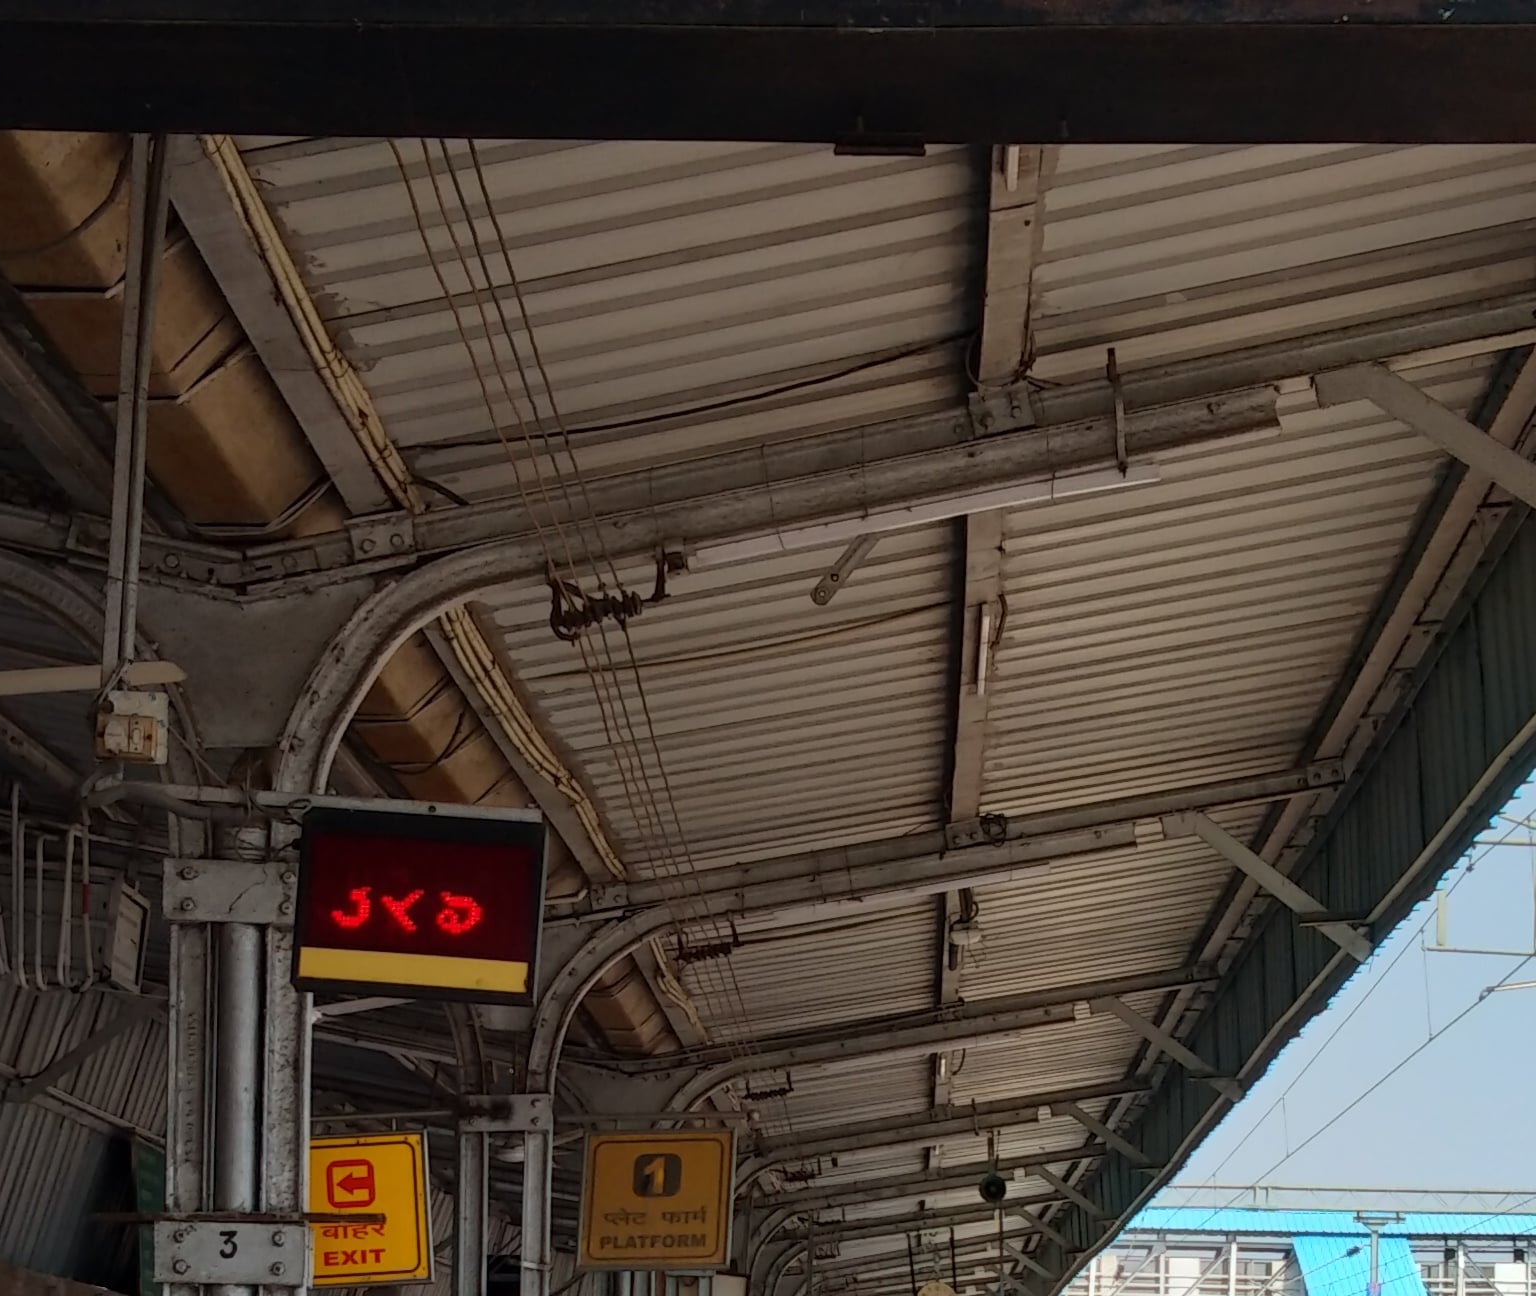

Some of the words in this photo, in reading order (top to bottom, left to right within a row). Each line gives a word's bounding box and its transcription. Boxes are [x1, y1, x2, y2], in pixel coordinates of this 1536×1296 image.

[644, 1157, 665, 1194] 1
[218, 1230, 239, 1260] 3
[599, 1233, 707, 1250] PLATFORM
[323, 1249, 386, 1267] EXIT
